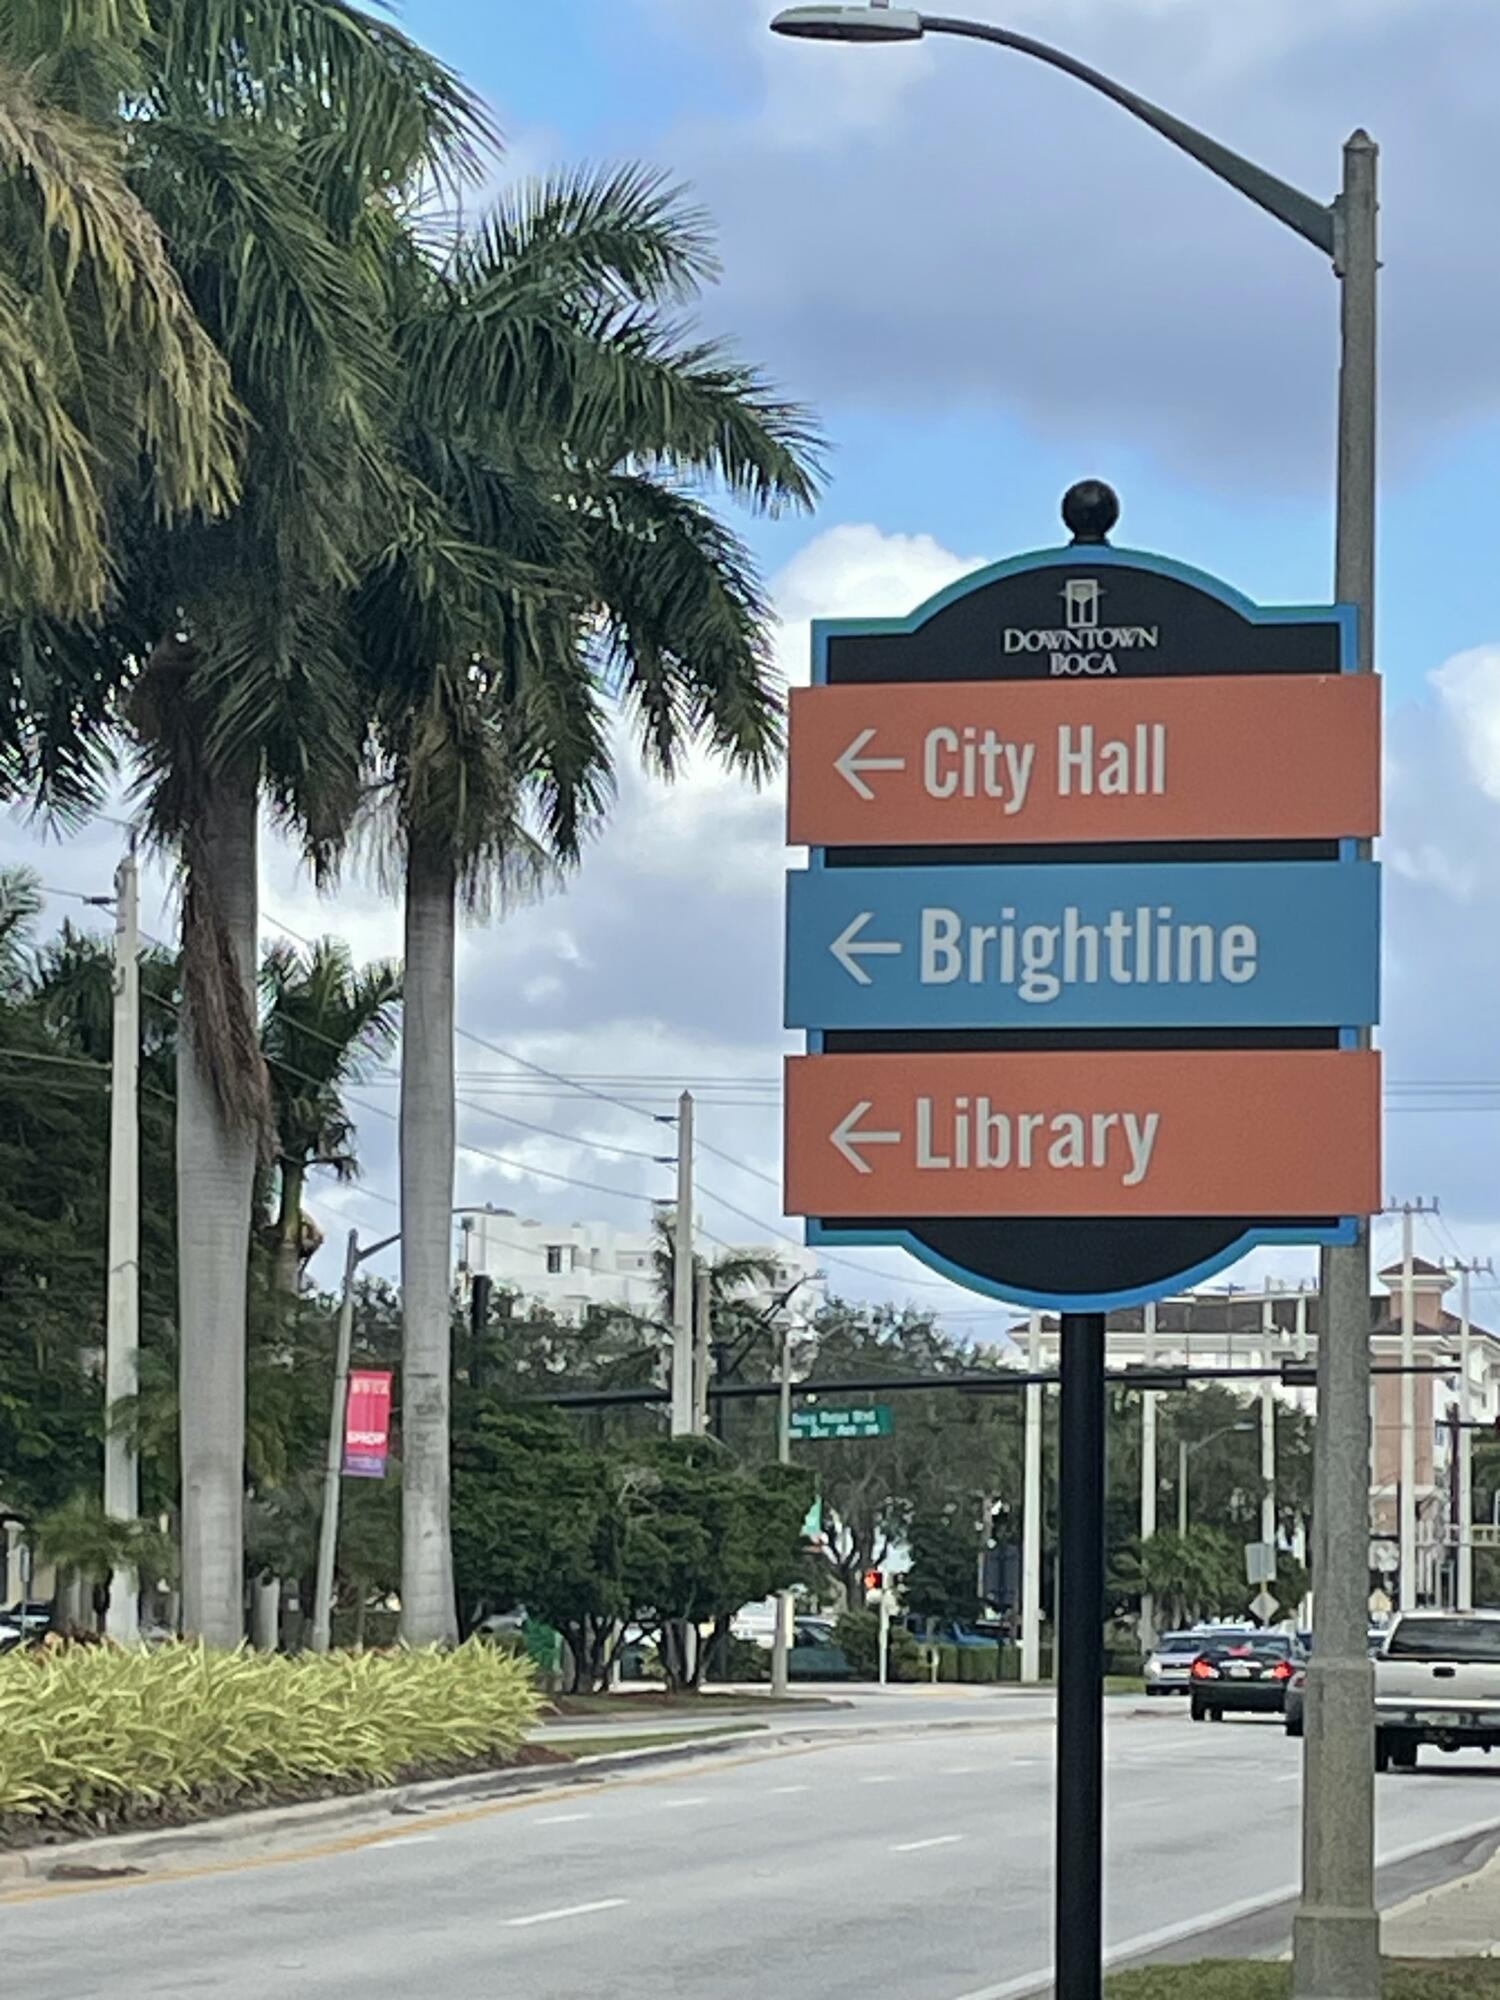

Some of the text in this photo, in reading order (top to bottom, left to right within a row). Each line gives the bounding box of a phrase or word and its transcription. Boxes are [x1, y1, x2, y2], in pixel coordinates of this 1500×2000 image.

[1004, 626, 1158, 653] DOWNTOWN
[1050, 653, 1118, 675] BOCA
[924, 724, 1165, 814] City Hall
[920, 906, 1258, 1002] Brightline
[915, 1097, 1159, 1186] Library
